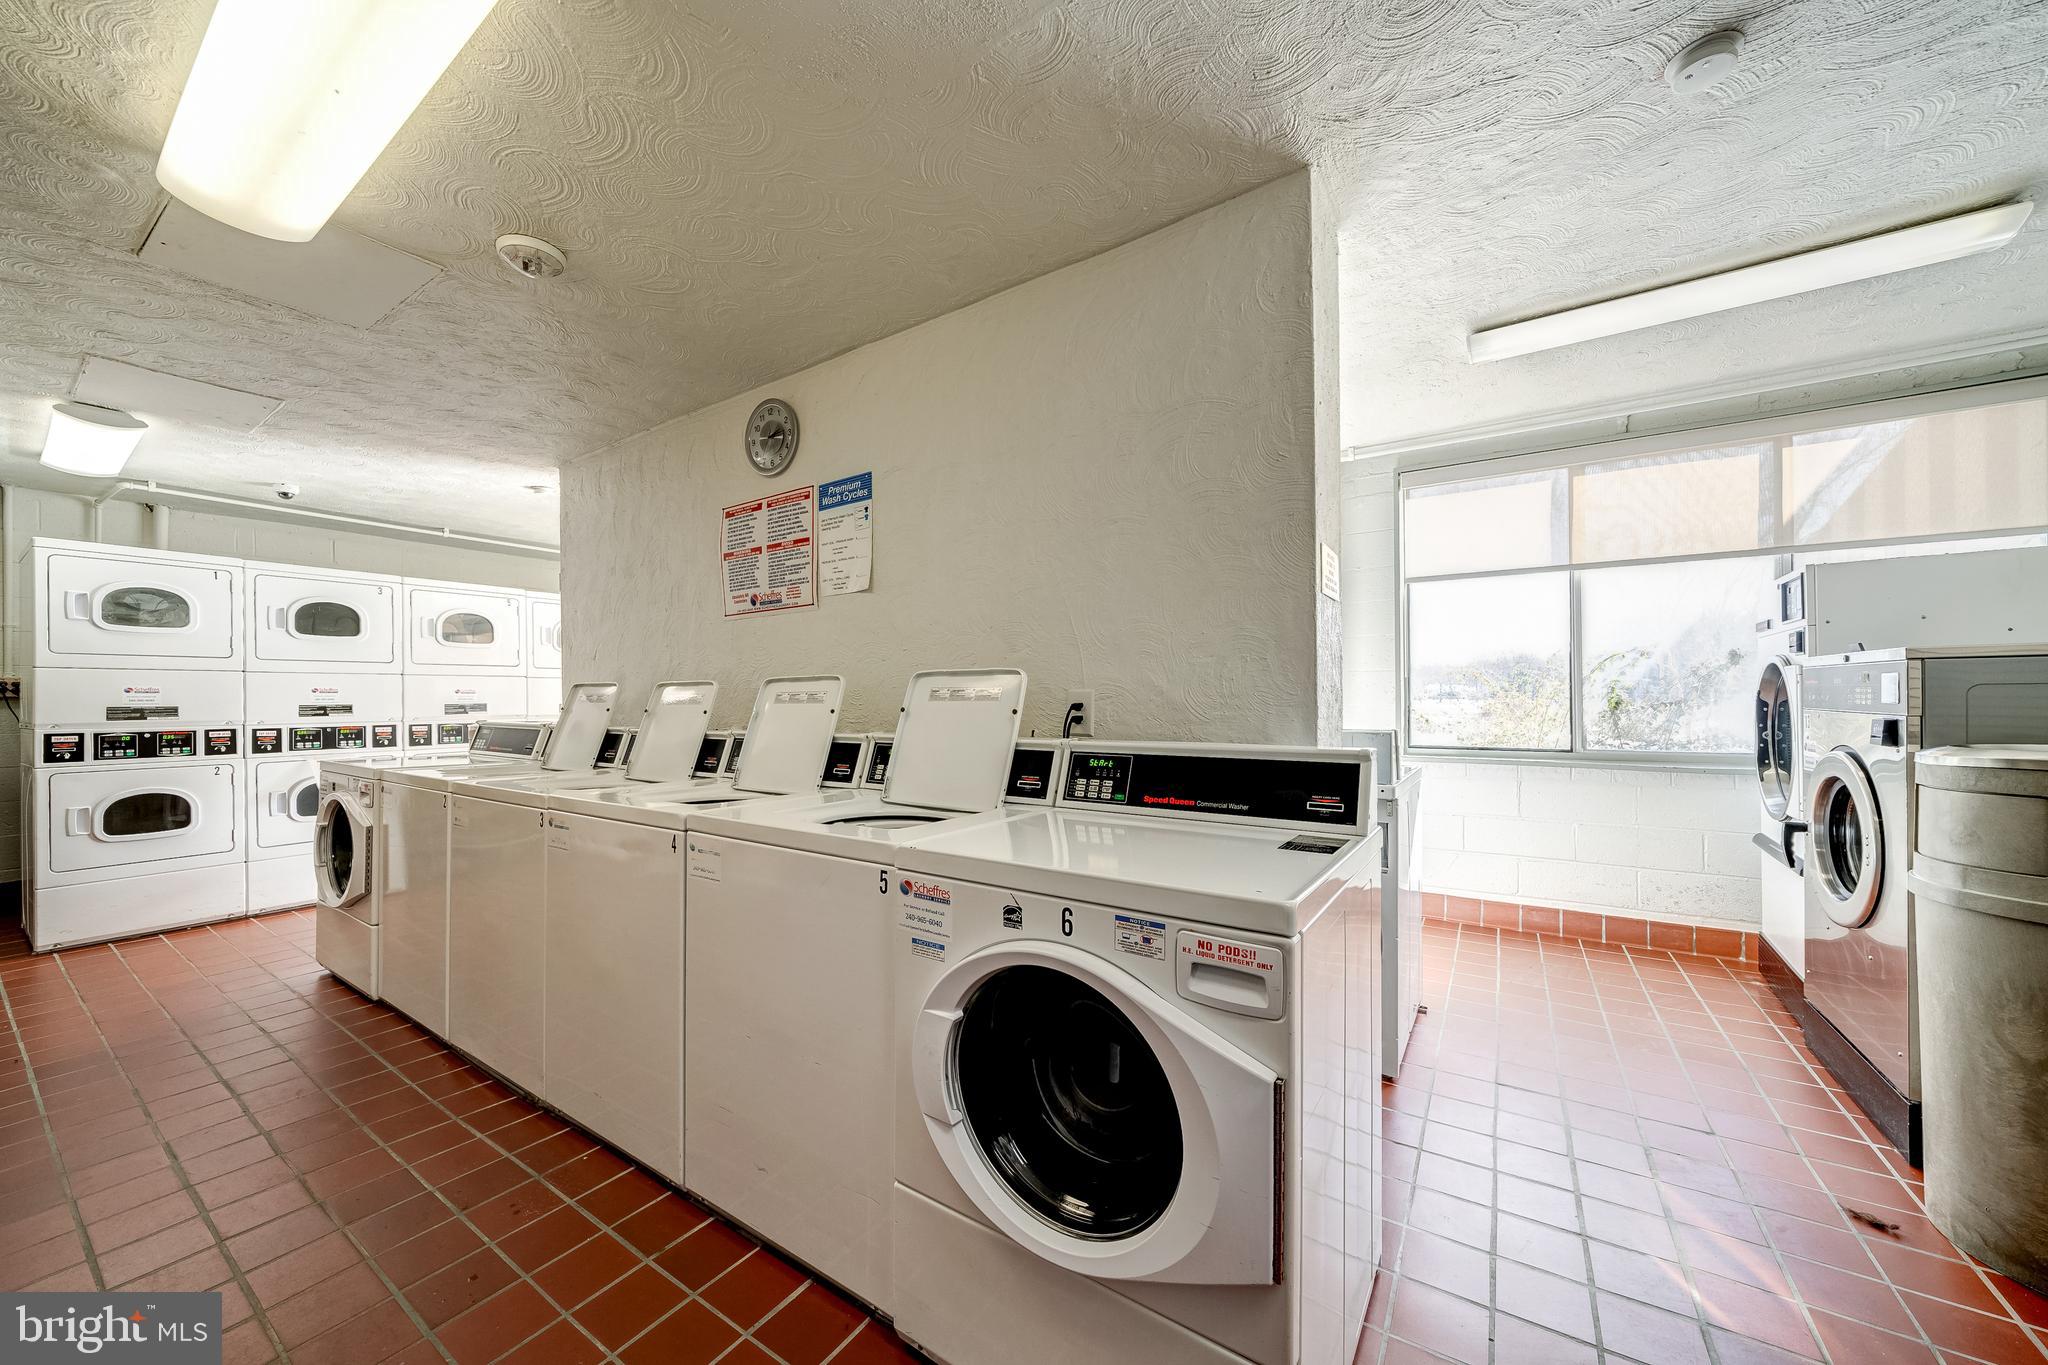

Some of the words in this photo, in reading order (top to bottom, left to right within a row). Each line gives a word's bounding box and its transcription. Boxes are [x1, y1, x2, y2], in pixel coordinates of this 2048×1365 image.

[828, 481, 861, 495] Premium
[822, 494, 841, 506] Wash
[842, 488, 868, 502] Cycles
[214, 571, 218, 580] 1
[378, 586, 382, 594] 3
[215, 766, 220, 775] 2
[443, 794, 447, 808] 2
[1144, 795, 1168, 803] Speed
[1170, 797, 1194, 805] Queen
[1196, 800, 1227, 808] Commercial
[1229, 802, 1249, 810] Washer
[540, 812, 544, 827] 3
[672, 834, 677, 853] 4
[880, 870, 888, 894] 5
[914, 881, 950, 899] Scheffres
[905, 912, 943, 928] 240-965-6040
[1062, 907, 1073, 937] 6
[916, 939, 940, 948] NOTICE
[1197, 940, 1212, 951] NO
[1218, 943, 1257, 960] PODS!!
[1182, 946, 1194, 955] H.E.
[1195, 949, 1215, 960] LIQUID
[1218, 953, 1254, 967] DETERGENT
[1257, 962, 1274, 971] ONLY
